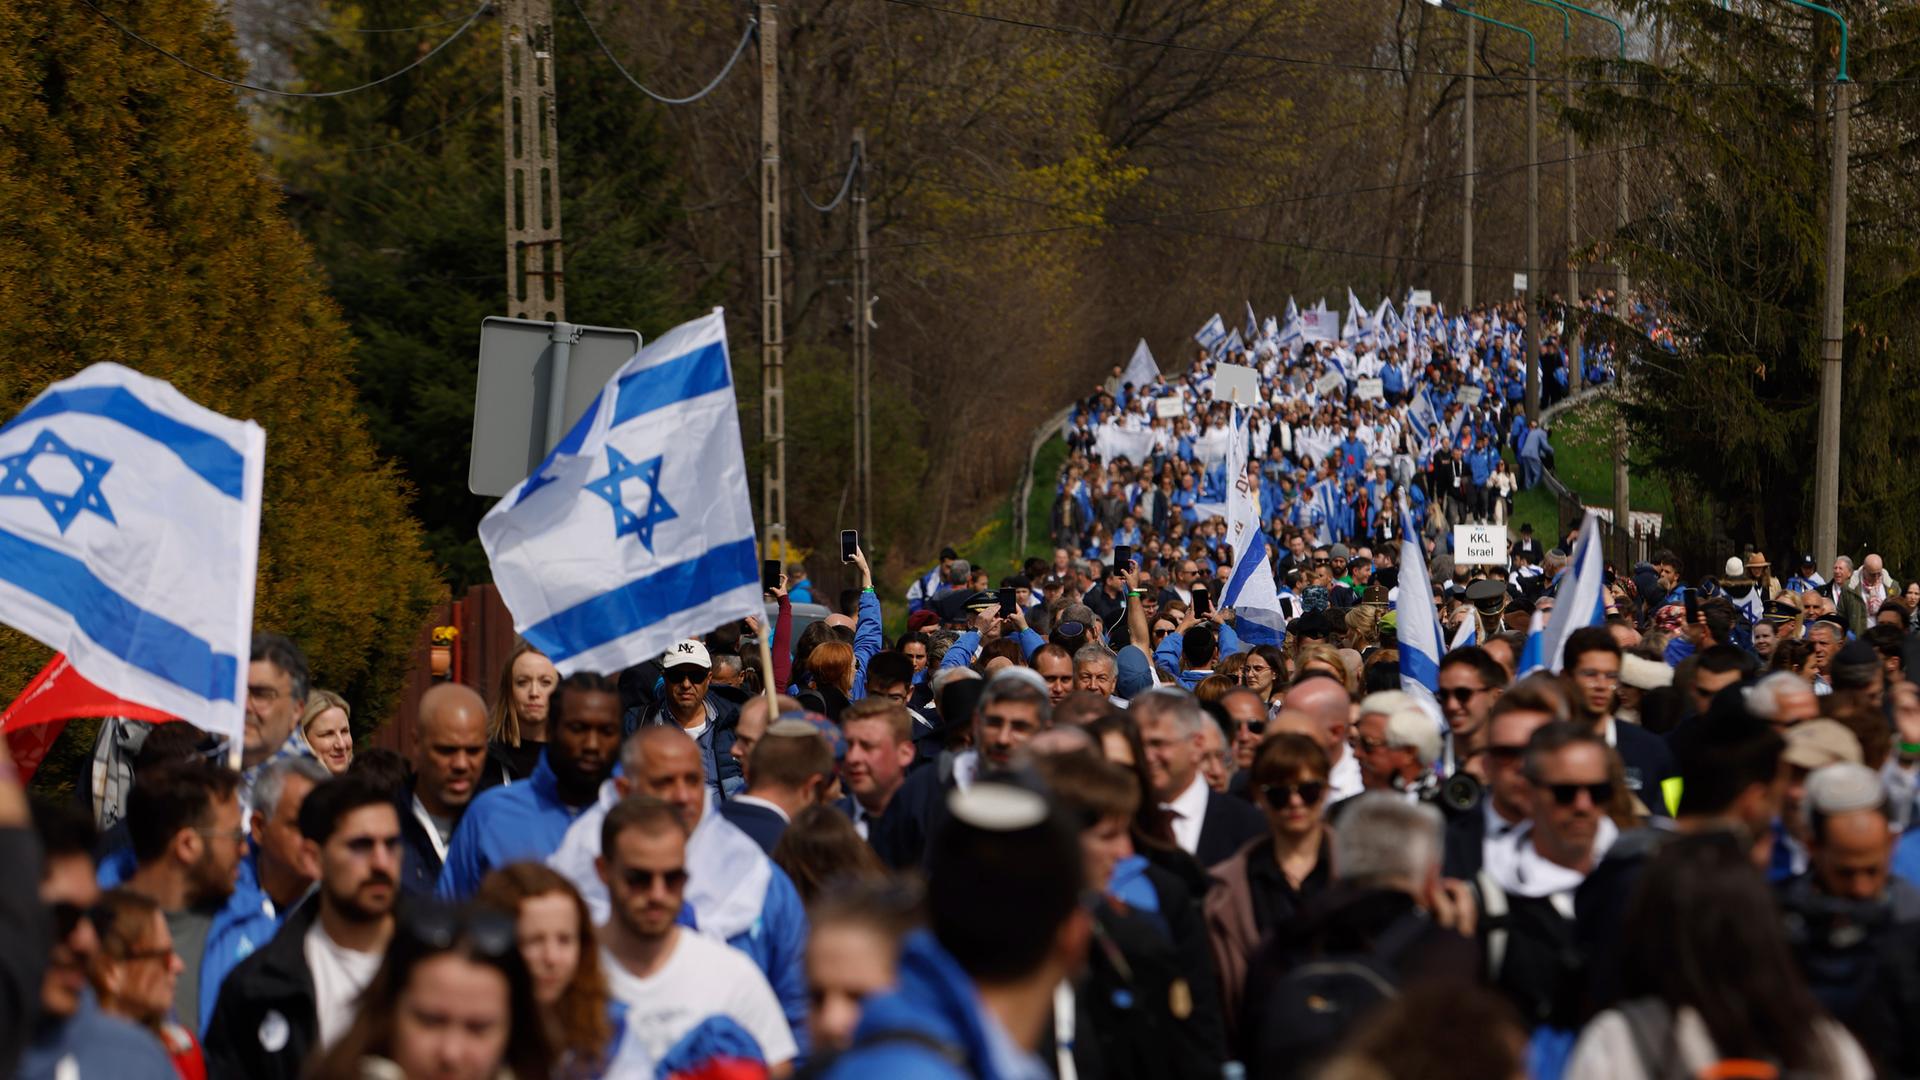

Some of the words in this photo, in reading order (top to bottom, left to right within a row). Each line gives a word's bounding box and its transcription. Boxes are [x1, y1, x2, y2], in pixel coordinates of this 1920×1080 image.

[1470, 534, 1491, 543] KKL
[1467, 547, 1494, 557] Israel
[678, 643, 694, 653] NY
